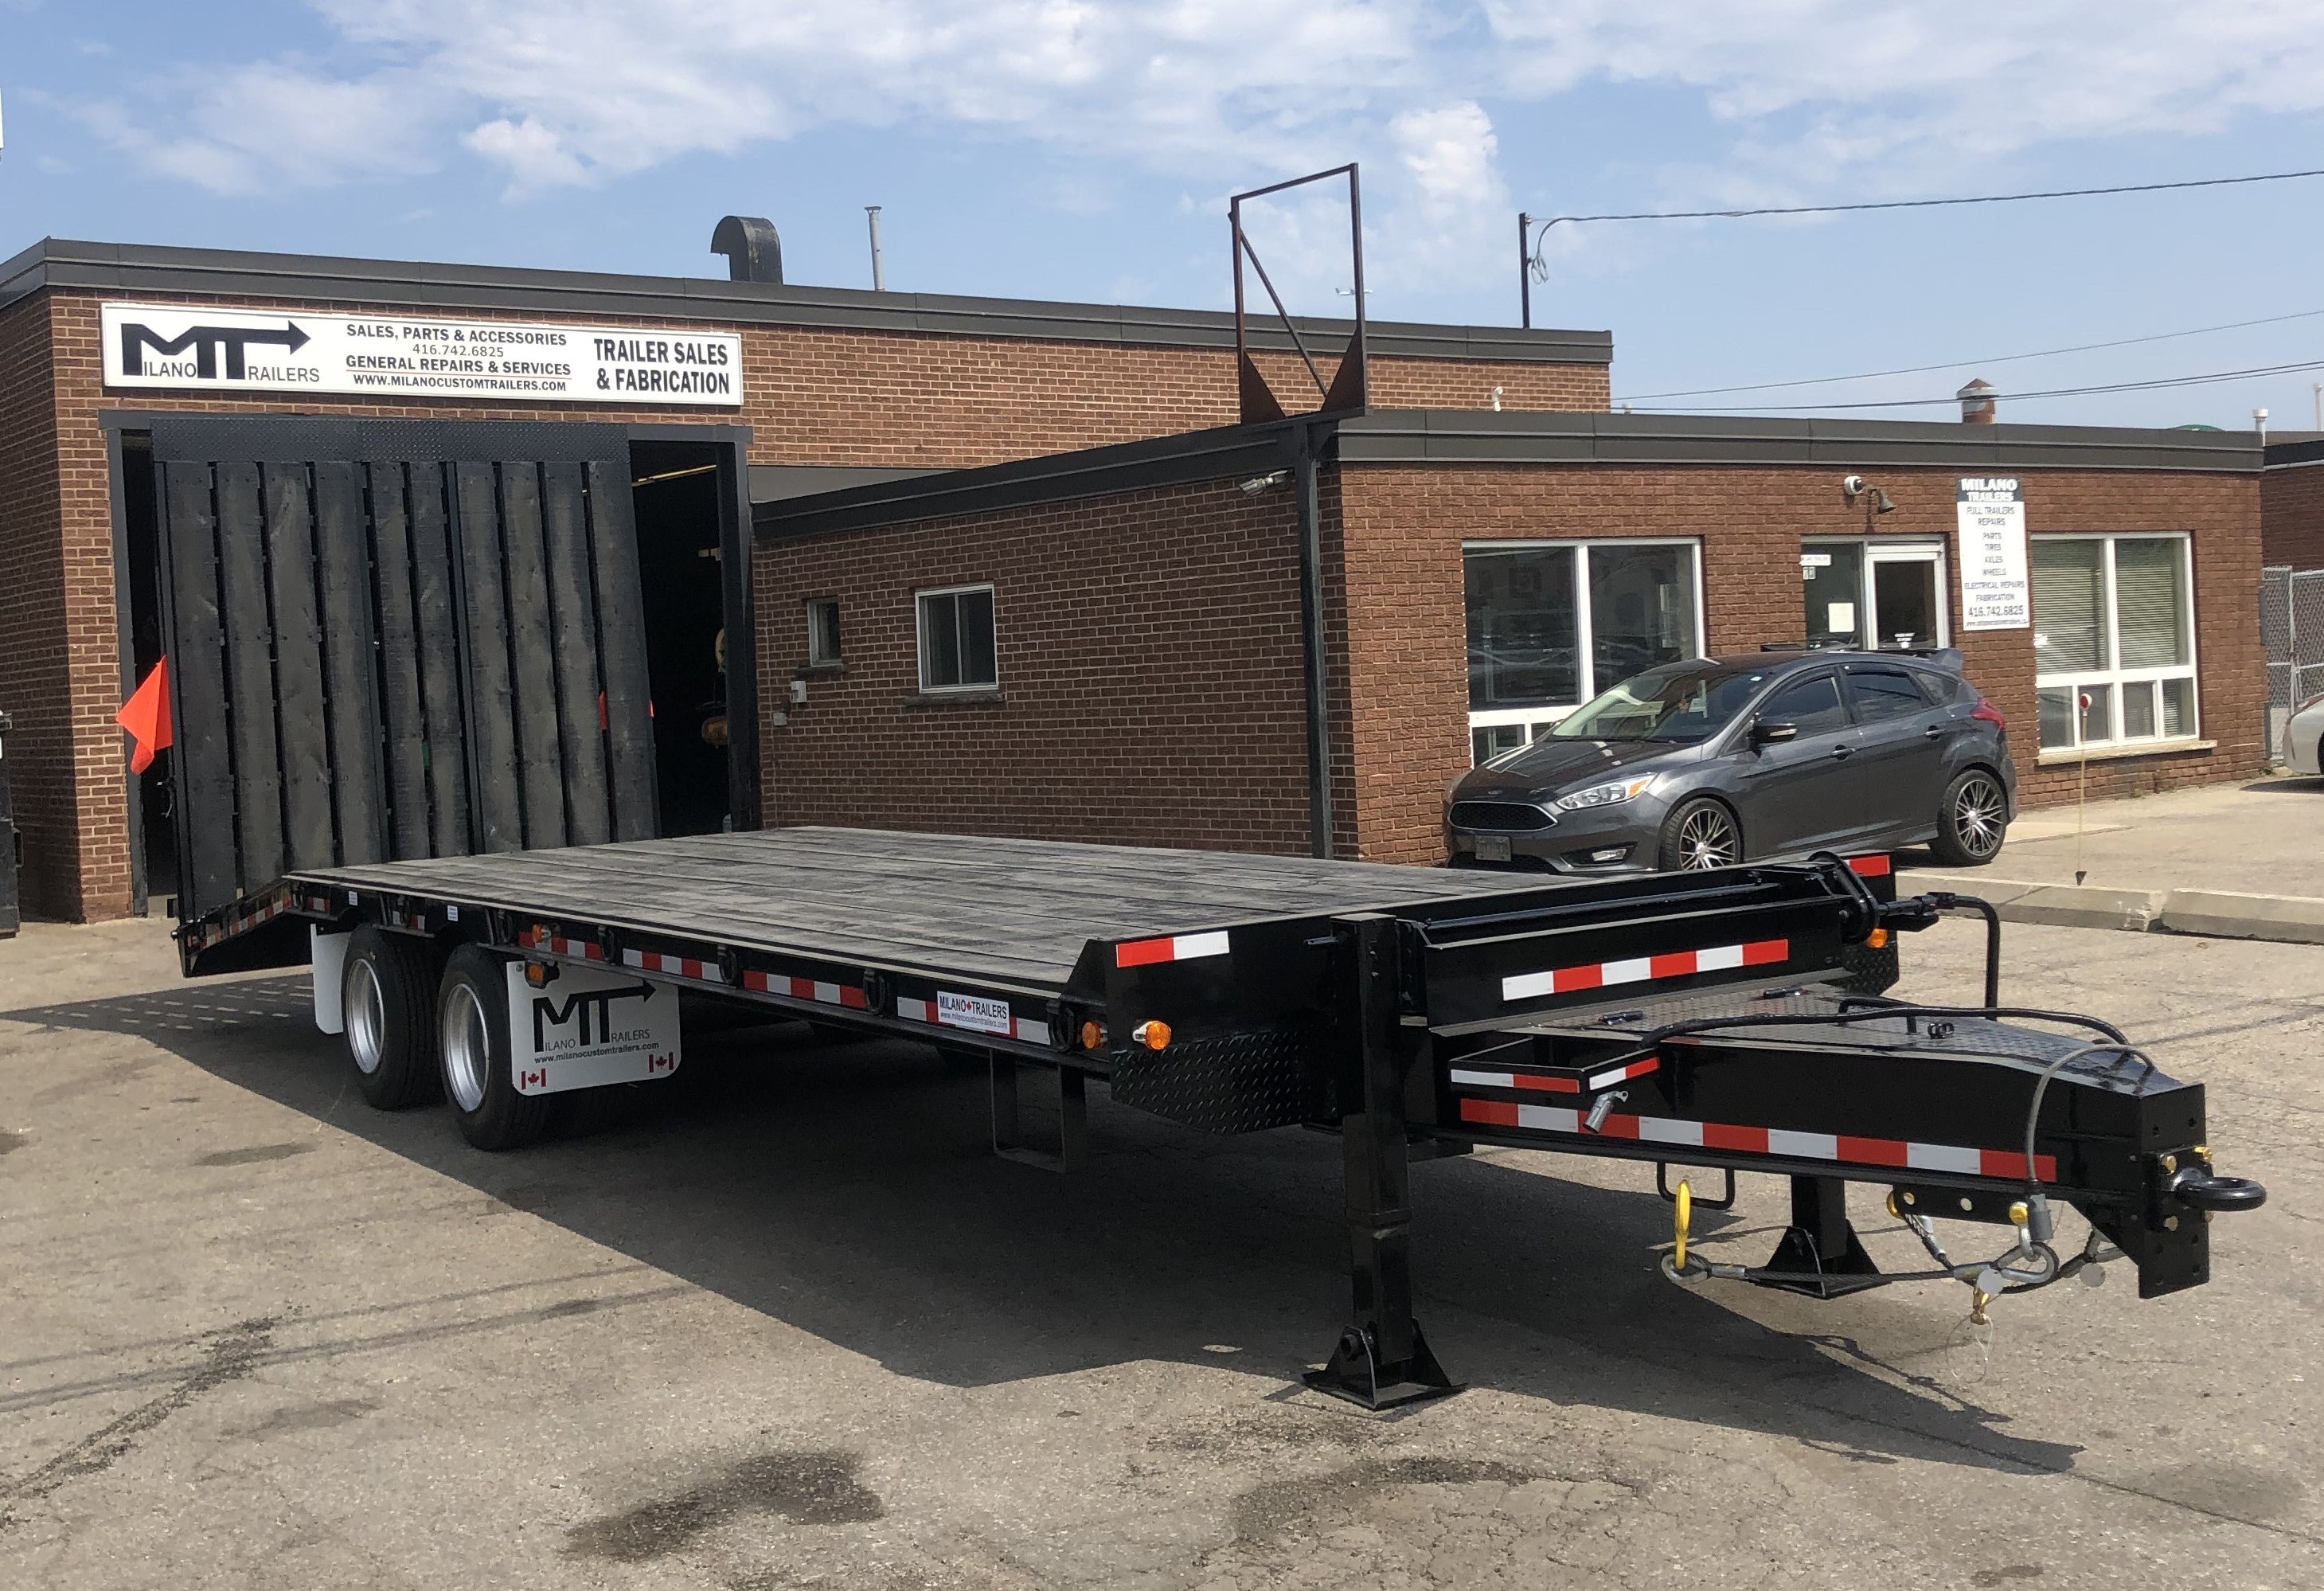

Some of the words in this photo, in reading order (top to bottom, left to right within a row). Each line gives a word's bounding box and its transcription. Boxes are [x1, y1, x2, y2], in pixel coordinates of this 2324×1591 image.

[346, 323, 399, 341] SALES,
[403, 326, 449, 341] PARTS
[454, 329, 465, 342] &
[469, 330, 567, 346] ACCESSORIES
[412, 343, 504, 358] 416.742.6825
[594, 338, 670, 364] TRAILER
[674, 341, 728, 366] SALES
[346, 354, 416, 370] GENERAL
[420, 358, 483, 373] REPAIRS
[488, 360, 499, 373] &
[502, 361, 572, 376] SERVICES
[353, 373, 567, 392] WWW.MILANOCUSTOMTRAILERS.COM
[596, 367, 611, 391] &
[615, 368, 730, 395] FABRICATION
[1960, 478, 2018, 491] MILANO
[1966, 491, 2014, 502] TRAILERS
[1984, 506, 2015, 515] TRAILERS
[1978, 518, 2006, 526] REPAIRS
[1968, 604, 2025, 617] 416.742.6825
[939, 995, 966, 1012] MILANO
[971, 1001, 1006, 1019] TRAILERS
[534, 1042, 659, 1064] www.milanocustomtrailers.com
